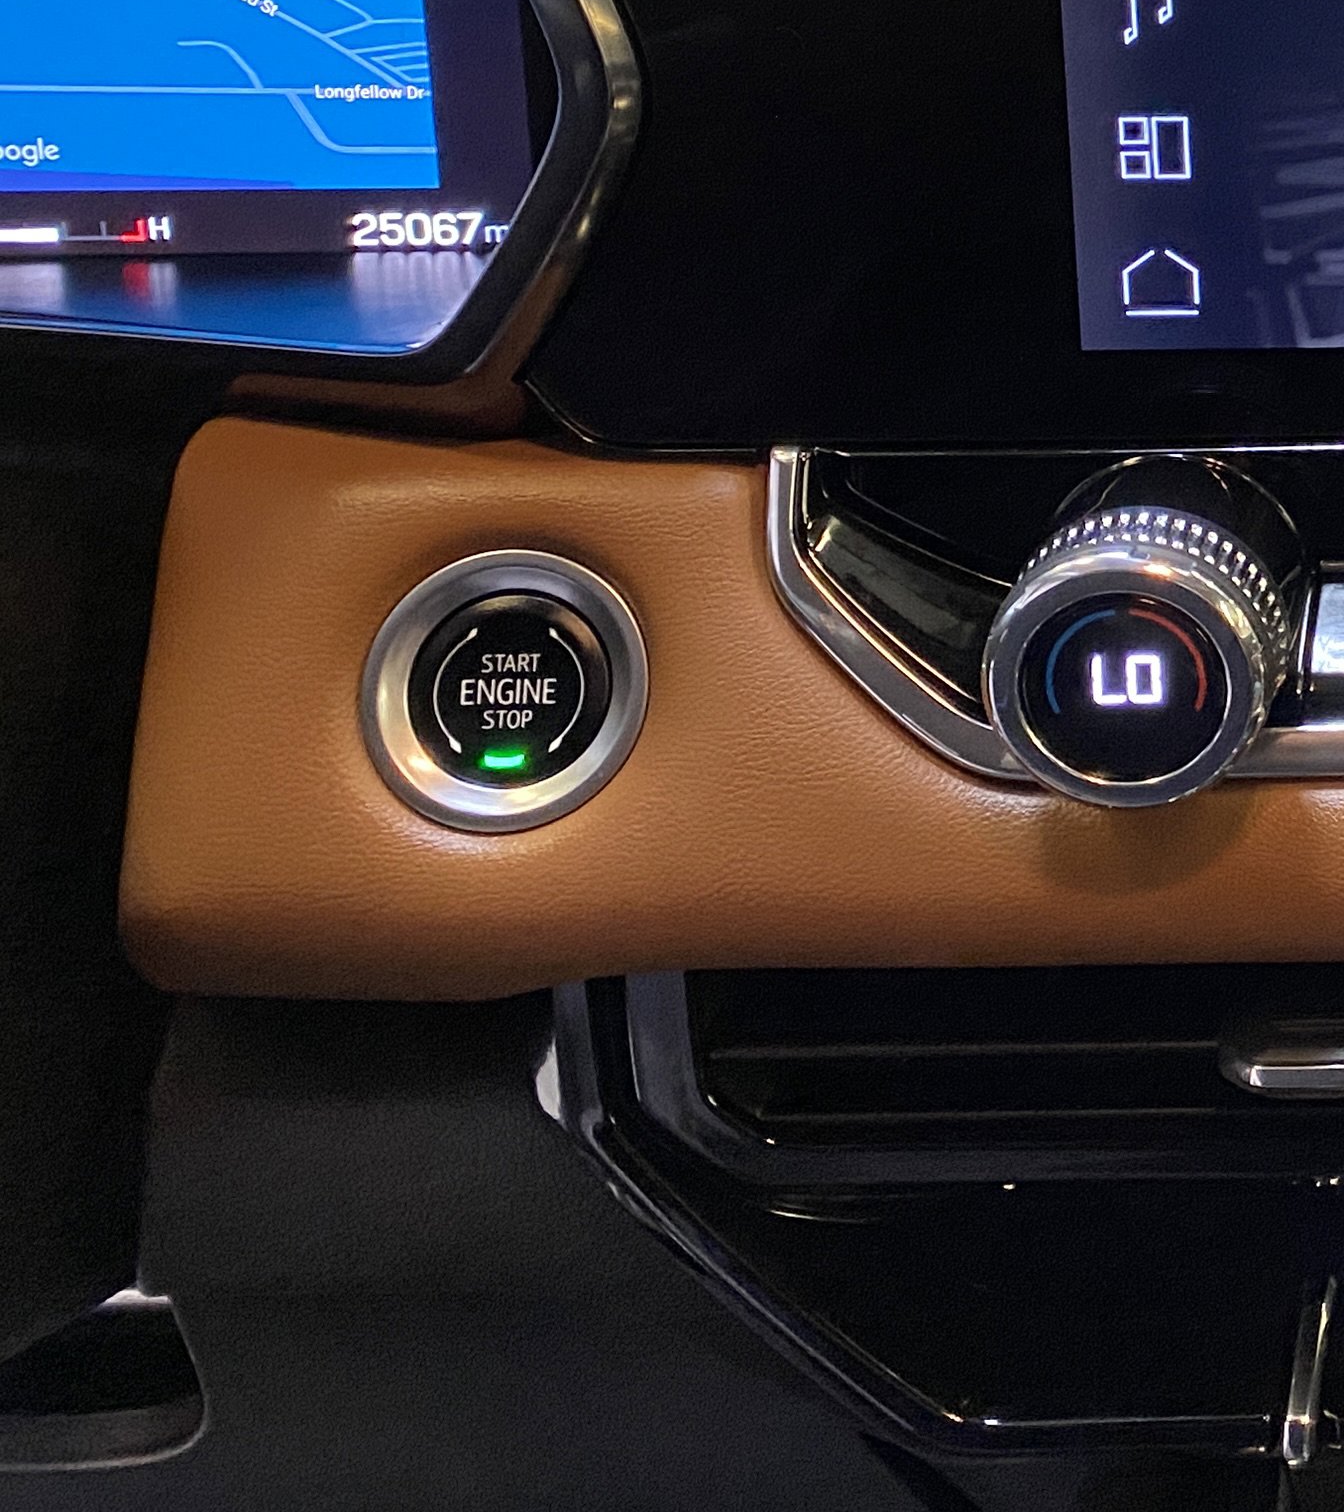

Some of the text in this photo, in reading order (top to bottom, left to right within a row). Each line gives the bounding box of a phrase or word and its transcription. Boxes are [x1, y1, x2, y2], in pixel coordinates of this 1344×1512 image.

[260, 0, 278, 16] St
[315, 84, 424, 101] Longfellow Dr
[0, 137, 60, 167] ogle
[148, 215, 171, 241] H
[351, 211, 484, 247] 25067
[481, 654, 540, 673] START
[461, 678, 556, 705] ENGINE
[1090, 652, 1163, 706] LO
[482, 710, 532, 729] STOP
